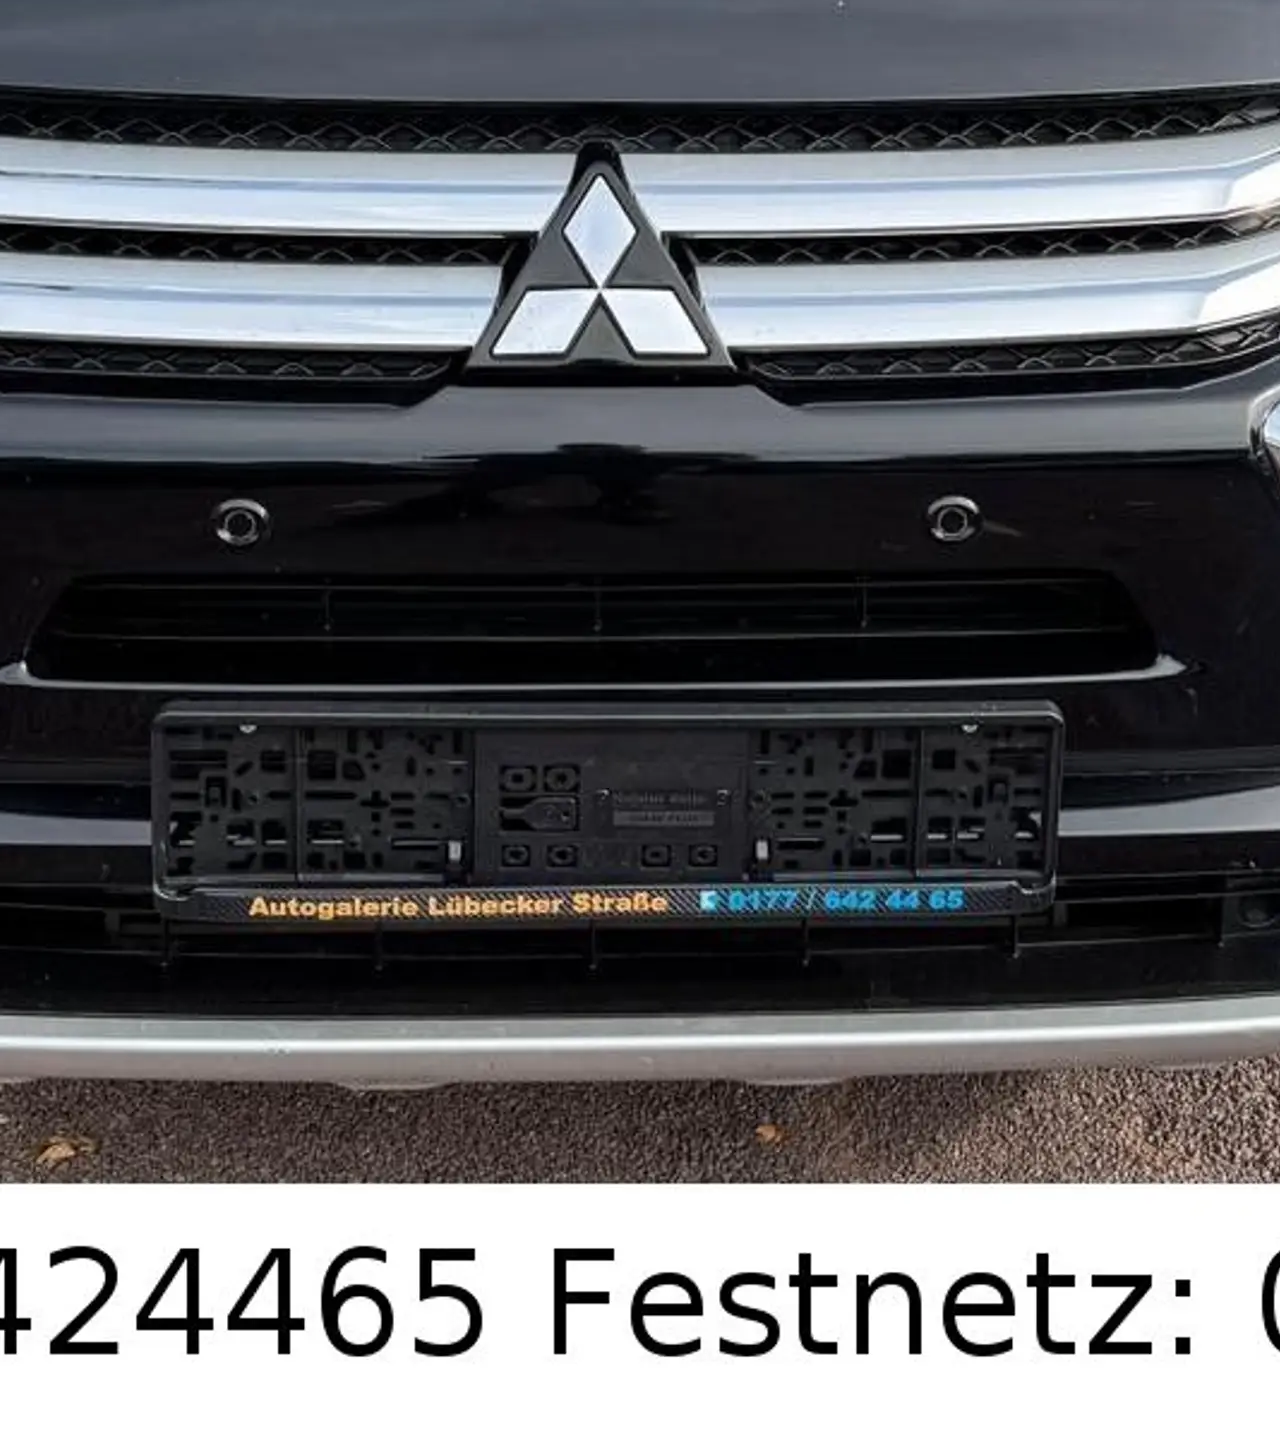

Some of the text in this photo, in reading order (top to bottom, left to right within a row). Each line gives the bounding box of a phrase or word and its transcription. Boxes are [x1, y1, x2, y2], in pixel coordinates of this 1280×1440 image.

[248, 895, 419, 920] Autogalerie
[428, 894, 563, 917] Lübecker
[571, 891, 669, 914] Straße
[728, 889, 797, 910] 0177
[824, 889, 876, 910] 642
[886, 888, 921, 910] 44
[928, 888, 965, 909] 65
